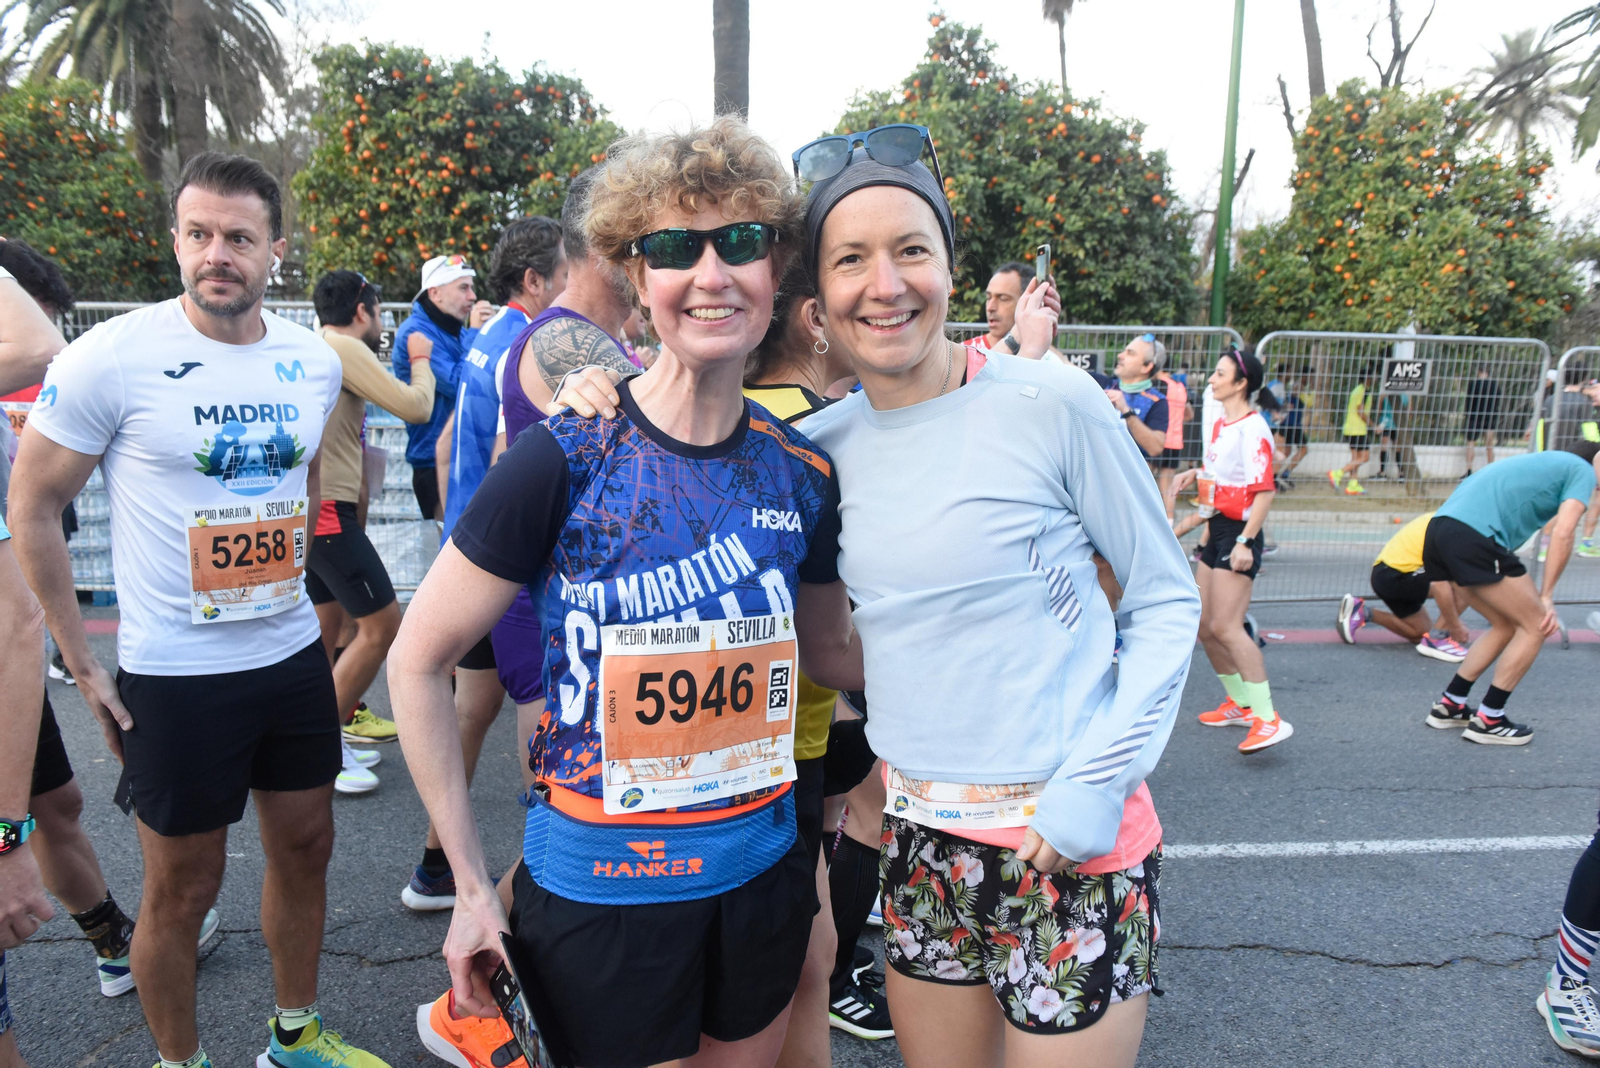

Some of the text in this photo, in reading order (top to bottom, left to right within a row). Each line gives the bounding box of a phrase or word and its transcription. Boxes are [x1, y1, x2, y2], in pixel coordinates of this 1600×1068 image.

[1392, 362, 1422, 378] AMS
[194, 403, 299, 425] MADRID
[247, 478, 273, 487] EDICIÓN
[195, 500, 295, 521] MEDIO MARATÓN SEVILLA
[752, 507, 803, 533] HOKA
[212, 529, 286, 570] 5258
[616, 533, 757, 620] MARATÓN
[254, 603, 272, 612] HOKA
[615, 616, 776, 646] MEDIO MARATÓN SEVILLA
[635, 662, 755, 725] 5946
[693, 780, 720, 794] HOKA
[935, 809, 962, 820] HOKA
[593, 858, 703, 877] HANKER
